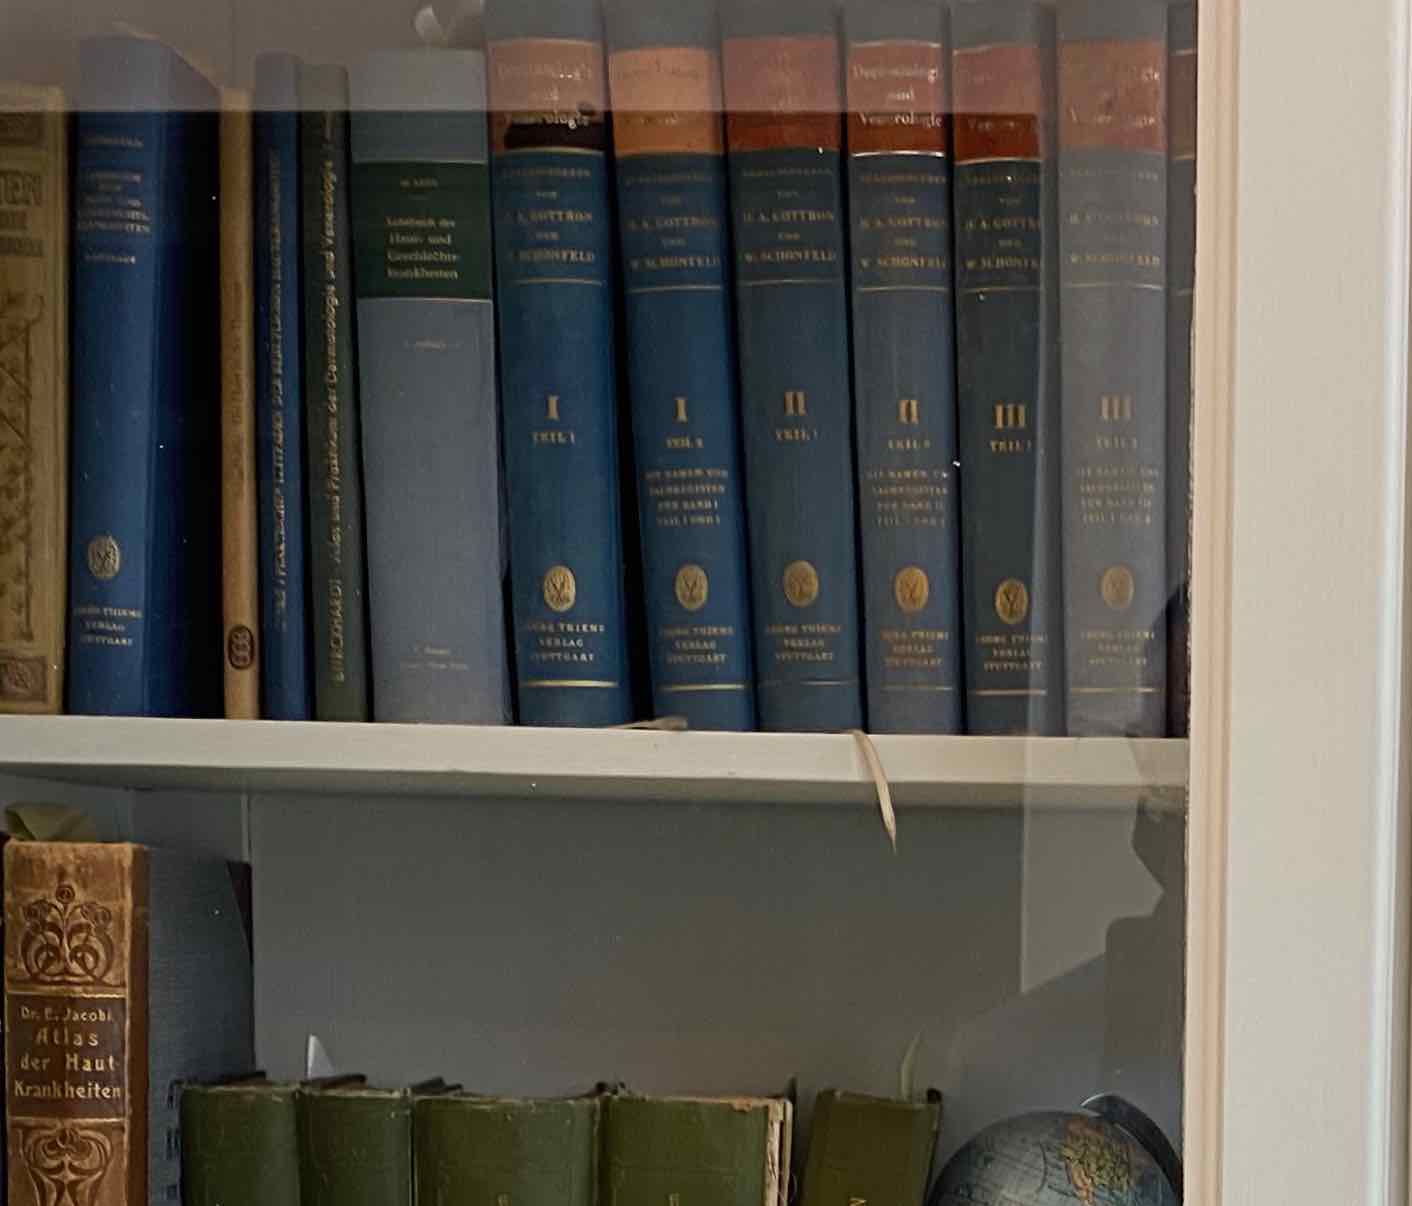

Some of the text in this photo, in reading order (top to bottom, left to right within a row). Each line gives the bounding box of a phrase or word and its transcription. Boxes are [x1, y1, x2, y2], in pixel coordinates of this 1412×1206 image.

[36, 1026, 99, 1047] Atlas
[20, 1053, 51, 1071] der
[14, 1079, 121, 1099] Krankheiten
